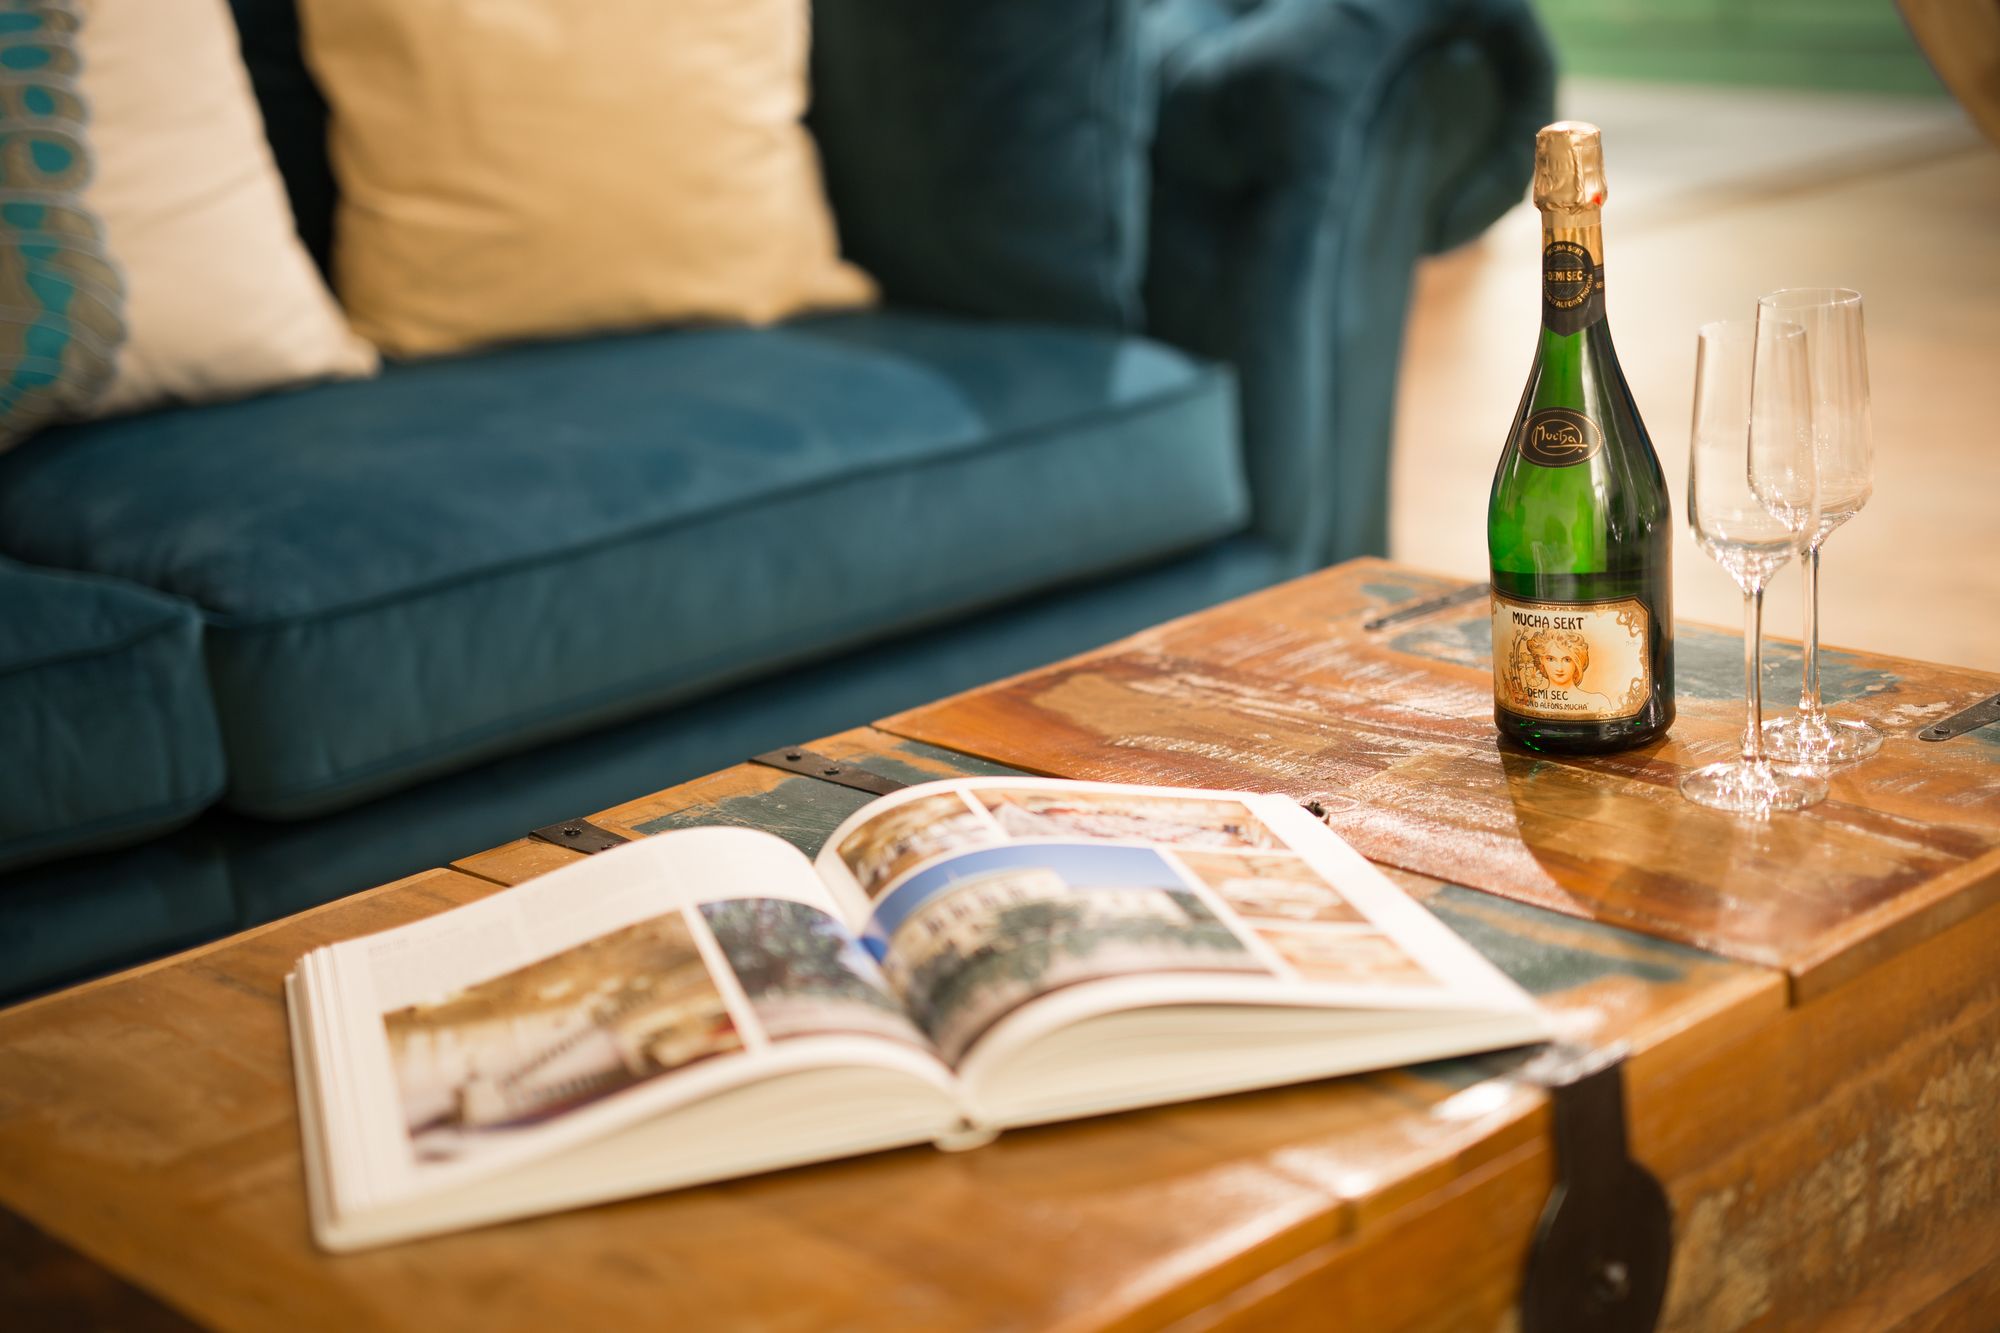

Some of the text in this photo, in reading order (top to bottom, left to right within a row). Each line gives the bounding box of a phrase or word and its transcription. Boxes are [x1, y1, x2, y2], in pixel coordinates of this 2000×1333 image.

[1547, 270, 1583, 281] DEMI SEC
[1512, 611, 1585, 630] MUCHA SEKT
[1527, 687, 1568, 701] DEMI SEC
